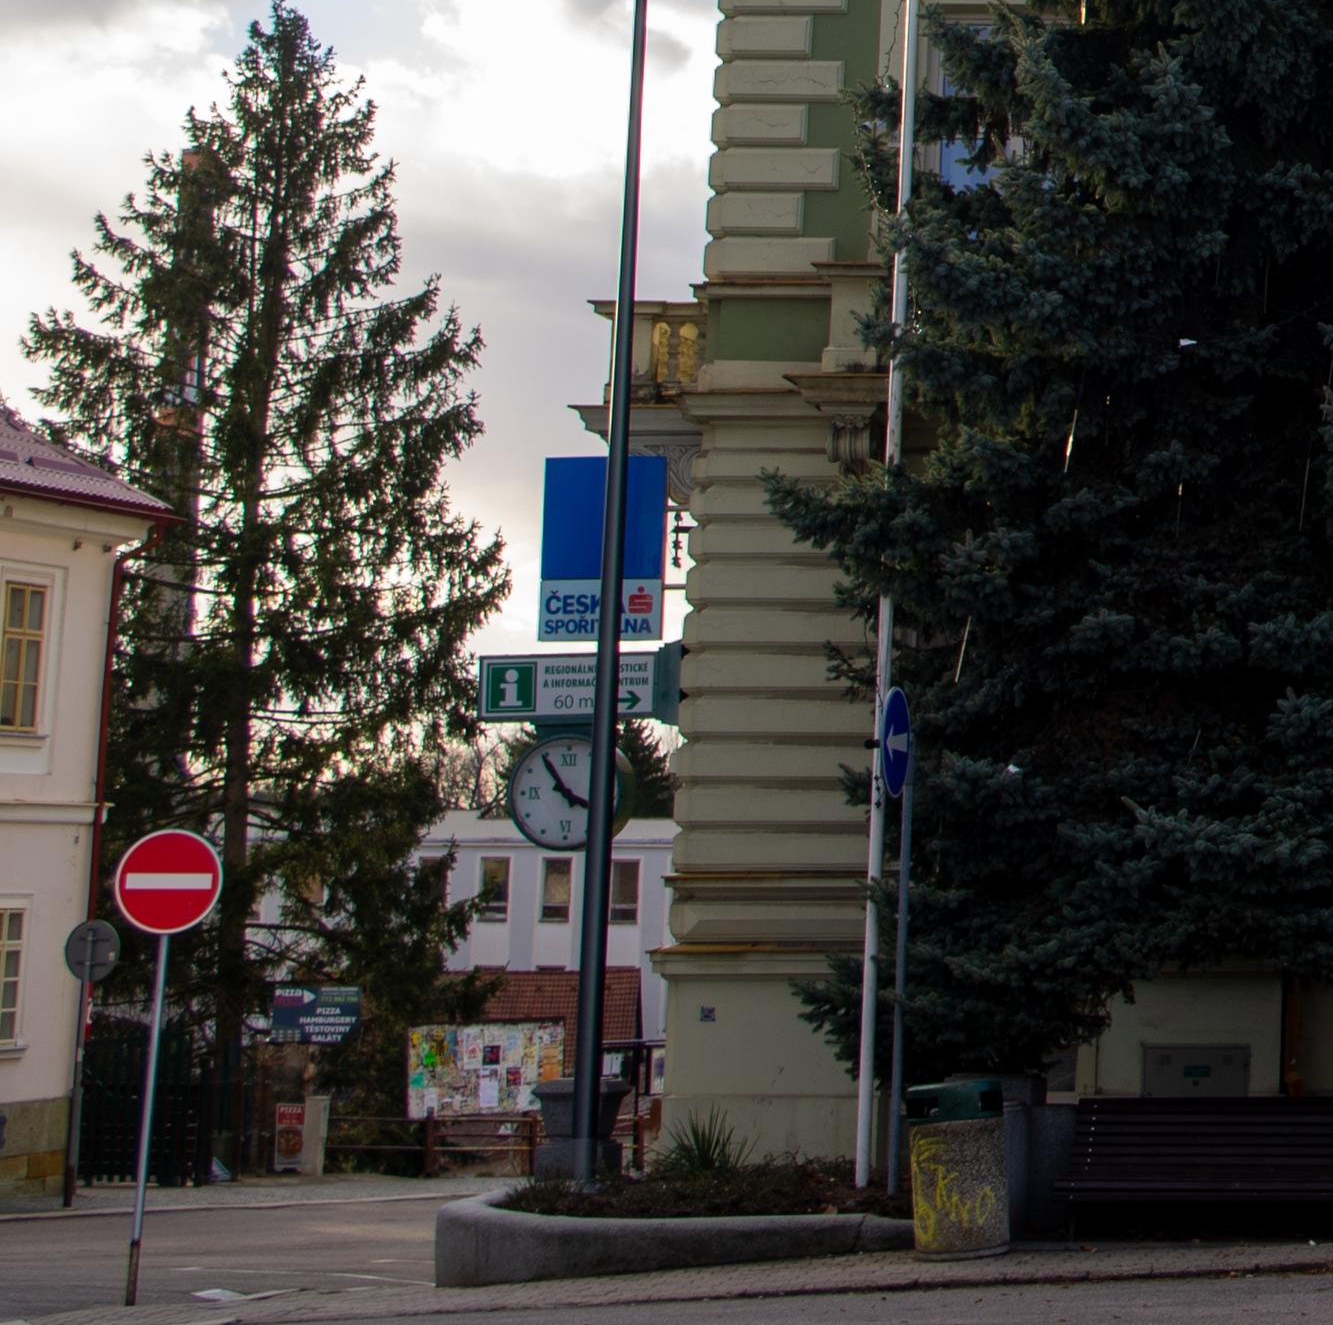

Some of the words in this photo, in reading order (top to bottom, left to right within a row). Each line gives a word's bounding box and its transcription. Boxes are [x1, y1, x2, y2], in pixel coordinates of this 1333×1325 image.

[545, 590, 626, 614] ČESK
[544, 616, 651, 634] SPOŘINA
[545, 662, 599, 675] REGIONÁLN
[543, 679, 549, 688] A
[554, 695, 574, 709] 60
[579, 697, 594, 709] m
[561, 753, 577, 767] XII
[528, 787, 541, 800] IX
[559, 820, 572, 833] VI
[316, 1007, 341, 1015] PIZZA
[299, 1016, 357, 1024] HAMBURGERY
[311, 1033, 343, 1042] SALÁTY
